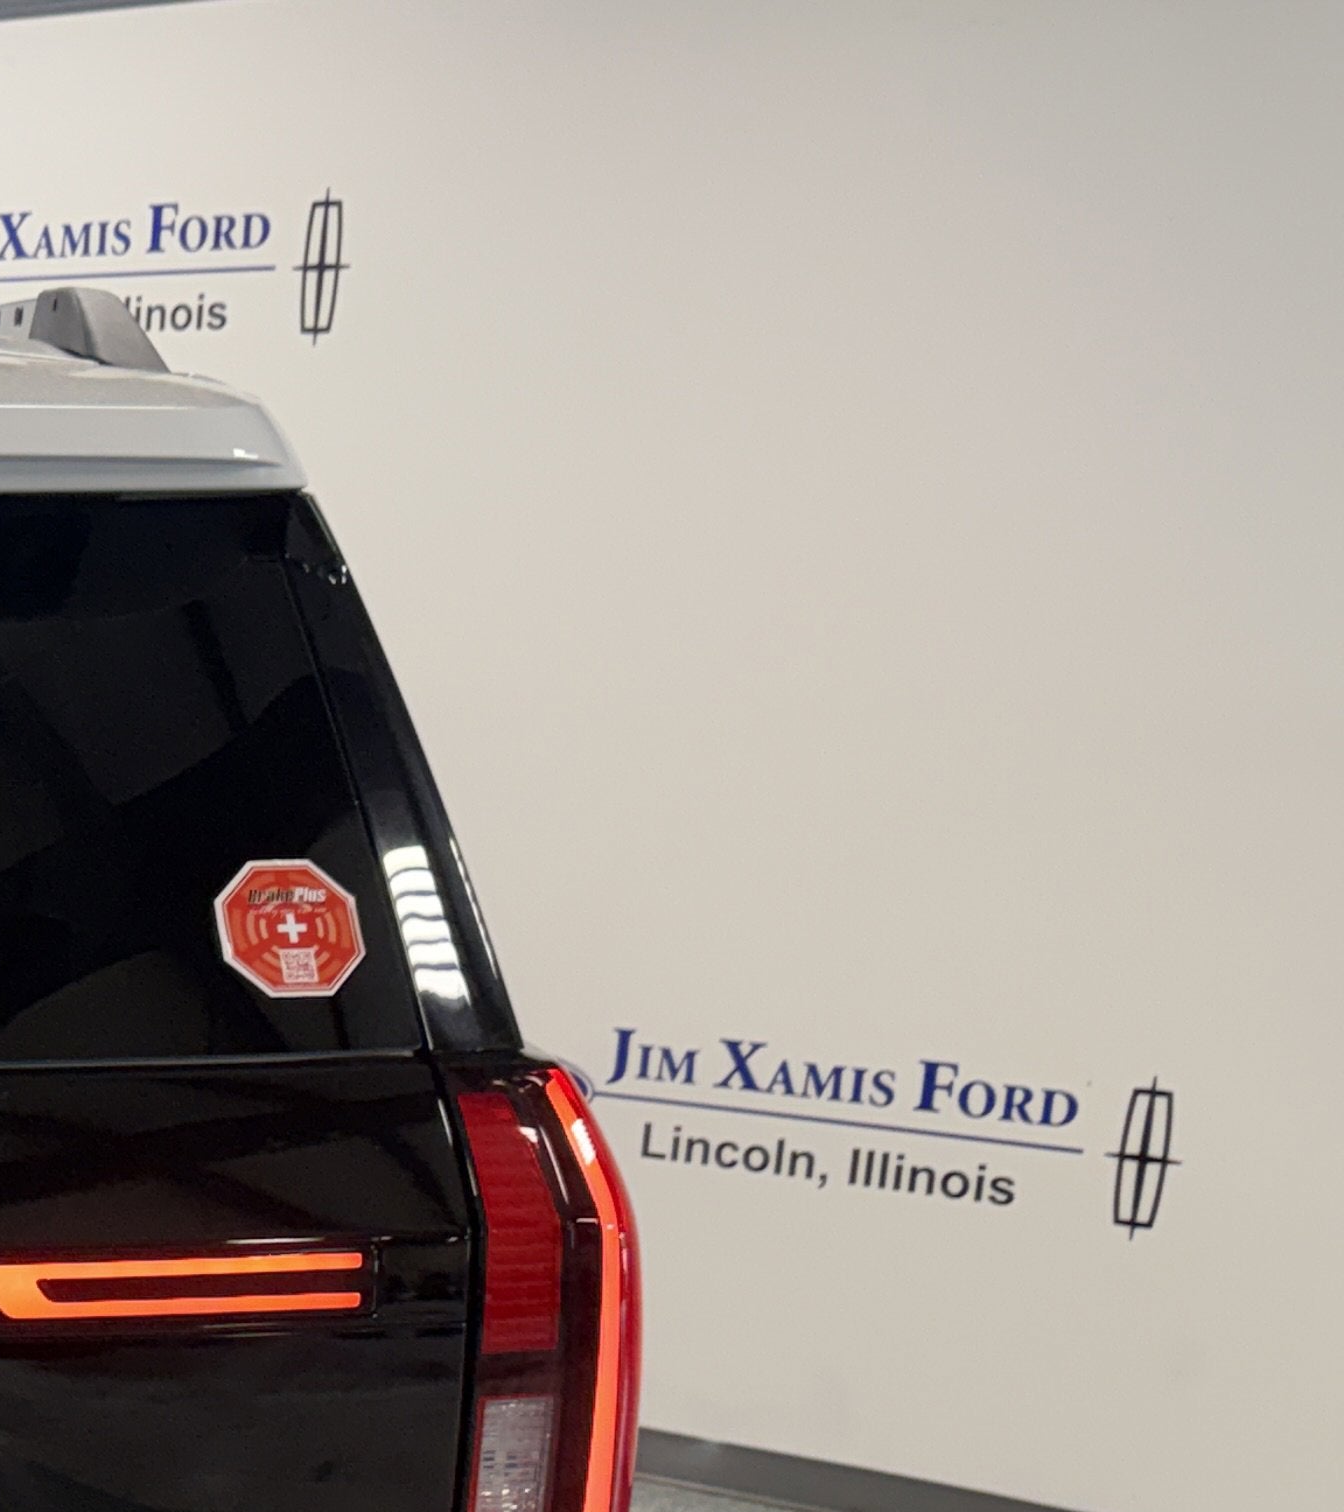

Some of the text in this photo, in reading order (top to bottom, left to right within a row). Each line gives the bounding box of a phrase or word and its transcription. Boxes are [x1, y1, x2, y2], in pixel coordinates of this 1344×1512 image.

[148, 202, 271, 250] FORD
[607, 1027, 1079, 1128] JIM XAMIS FORD
[641, 1122, 1016, 1206] Lincoln, Illinois
